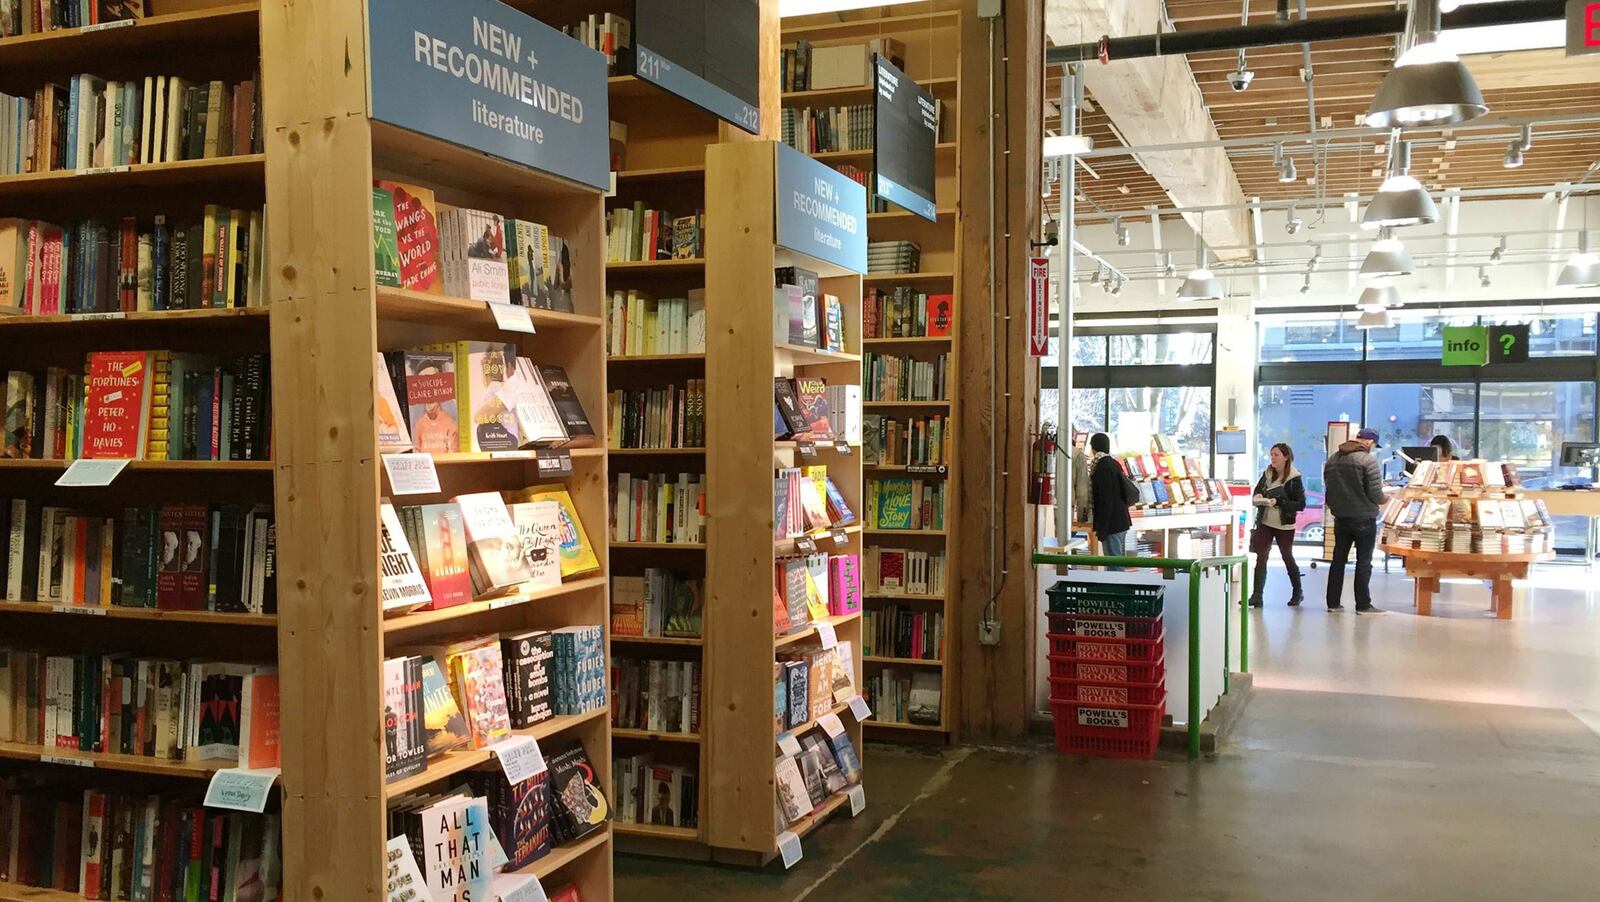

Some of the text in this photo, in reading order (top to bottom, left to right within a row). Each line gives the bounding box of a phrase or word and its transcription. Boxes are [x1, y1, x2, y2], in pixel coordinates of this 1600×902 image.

[473, 16, 538, 70] NEW +
[640, 52, 659, 80] 211
[414, 30, 584, 124] RECOMMENDED
[472, 99, 544, 144] literature
[743, 106, 758, 129] 212
[814, 176, 833, 201] NEW
[397, 201, 409, 212] THE
[793, 190, 857, 234] RECOMMENDED
[394, 209, 426, 232] WANGS
[414, 228, 424, 238] THE
[814, 226, 841, 250] literature
[399, 240, 431, 267] WORLD
[472, 262, 506, 276] Ali Smith
[1034, 268, 1046, 277] FIRE
[403, 262, 437, 290] JADE CHANG
[1448, 334, 1516, 355] info ?
[108, 362, 124, 372] THE
[484, 364, 504, 374] BOY
[92, 376, 138, 386] FORTUNES
[799, 381, 826, 394] Weird
[410, 390, 432, 399] CLAIRE
[98, 408, 124, 416] PETER
[103, 422, 116, 432] HO
[94, 438, 123, 448] DAVIES
[889, 493, 912, 507] LOVE
[880, 506, 909, 527] STORY
[266, 548, 274, 578] Tennis
[382, 553, 414, 577] NIGHT
[398, 584, 424, 598] MORRIS
[1078, 600, 1124, 609] POWELL'S
[1078, 608, 1124, 616] BOOKS
[1077, 622, 1124, 631] POWELL'S
[578, 626, 601, 642] FATES
[531, 646, 542, 656] the
[1077, 644, 1124, 652] POWELL'S
[520, 650, 554, 666] association
[1078, 650, 1124, 660] BOOKS
[534, 661, 540, 671] of
[577, 656, 604, 672] FURIES
[1078, 666, 1124, 674] POWELL'S
[395, 672, 400, 680] A
[530, 666, 546, 679] small
[1079, 672, 1125, 682] BOOKS
[386, 680, 422, 697] NTLEMAN
[528, 676, 548, 688] bombs
[534, 686, 548, 698] novel
[1079, 688, 1126, 696] POWELL'S
[1080, 694, 1126, 704] BOOKS
[531, 702, 548, 714] karan
[1080, 709, 1127, 718] POWELL'S
[387, 712, 416, 727] OSCOW
[527, 709, 552, 724] mahajan
[1086, 717, 1120, 726] BOOKS
[386, 745, 424, 764] OR TOWLES
[440, 808, 474, 834] ALL
[436, 832, 480, 862] THAT
[441, 860, 480, 888] MAN
[454, 890, 470, 902] IS
